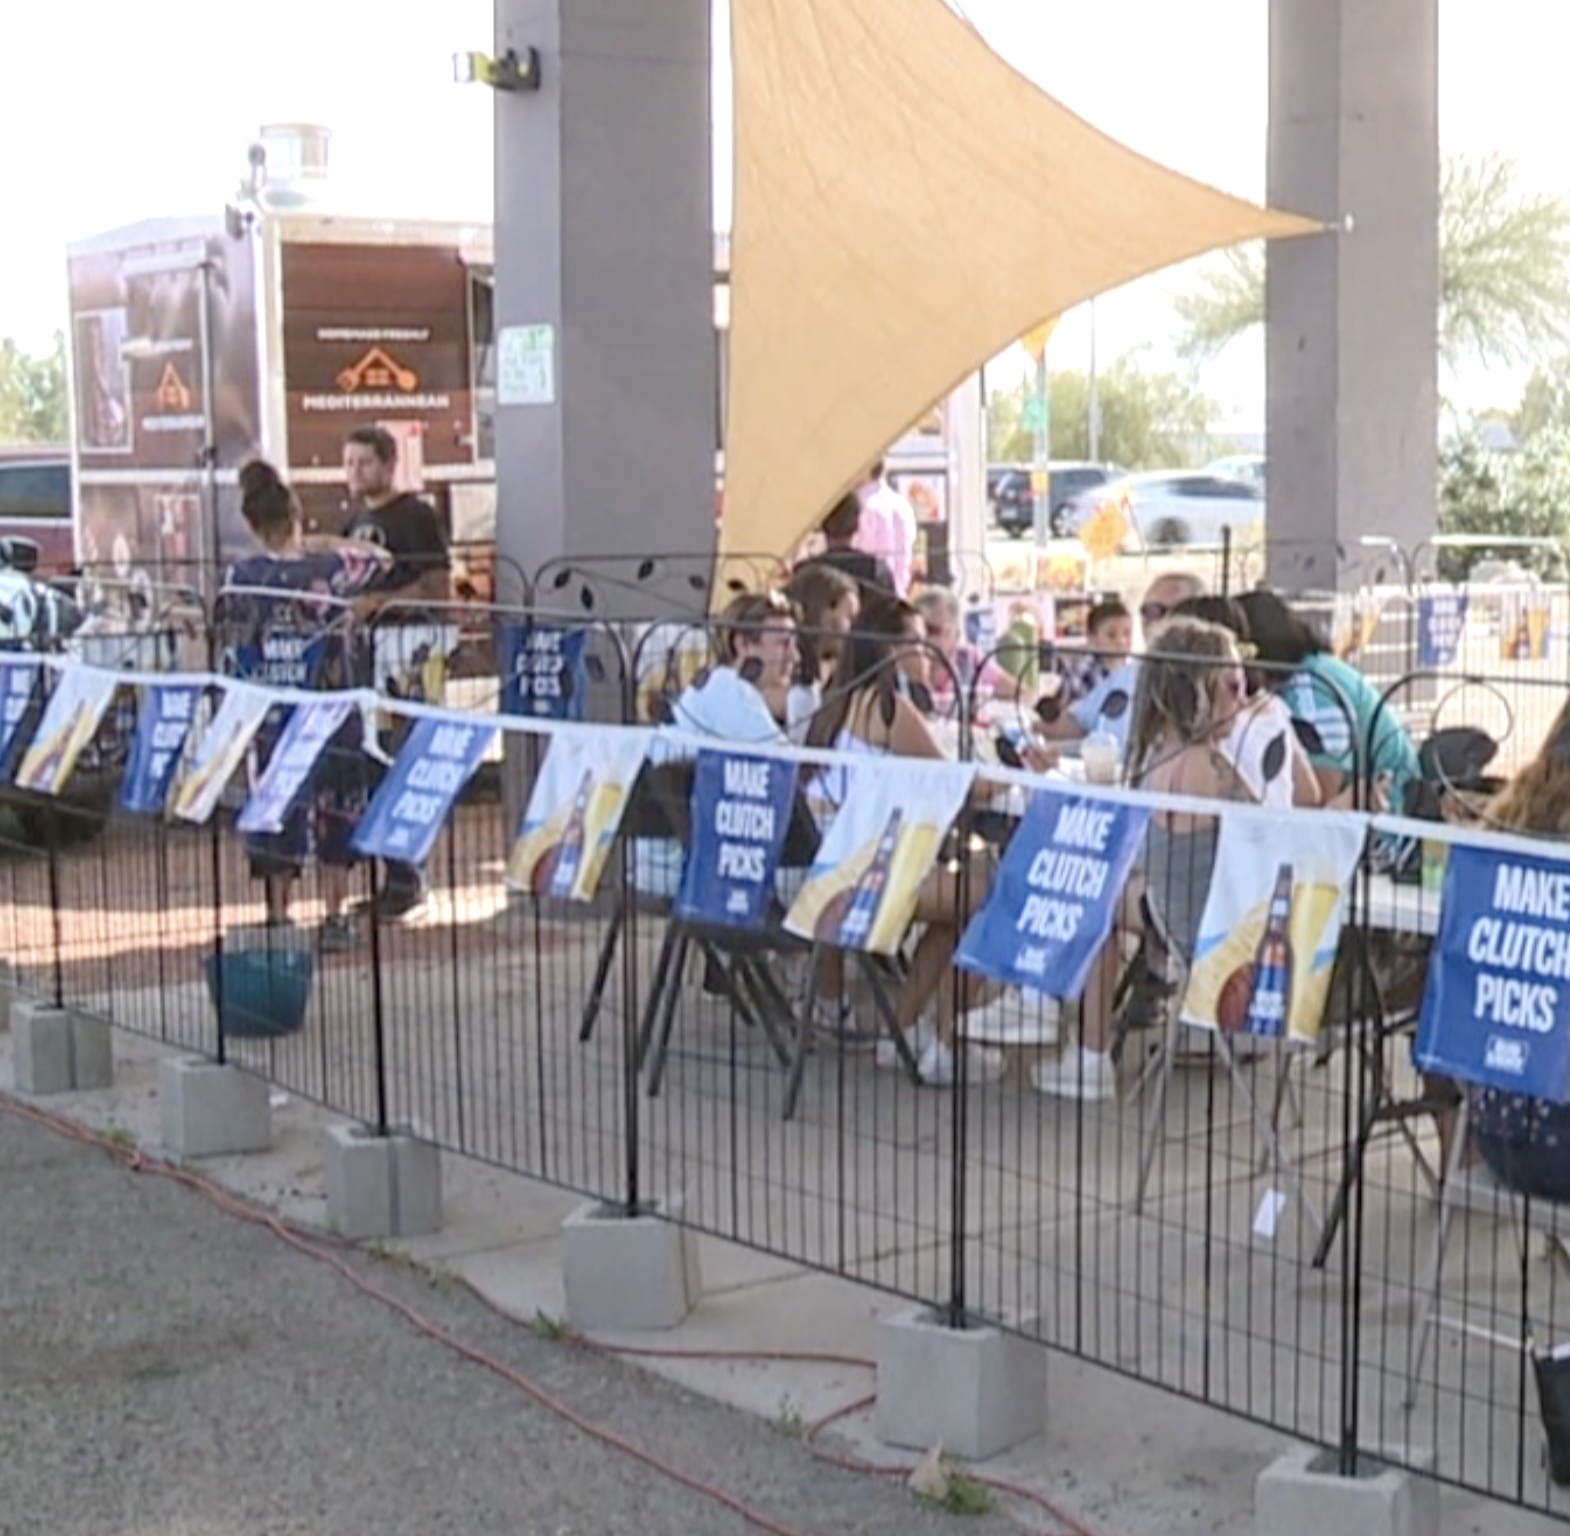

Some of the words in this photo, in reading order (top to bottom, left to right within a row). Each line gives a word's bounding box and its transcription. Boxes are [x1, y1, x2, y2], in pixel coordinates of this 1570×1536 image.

[723, 759, 770, 800] MAKE
[714, 799, 775, 841] CLUTCH
[1053, 804, 1116, 852] MAKE
[718, 842, 766, 884] PICKS
[1026, 848, 1109, 900] CLUTCH
[1016, 893, 1084, 944] PICKS
[1474, 972, 1557, 1033] PICKS
